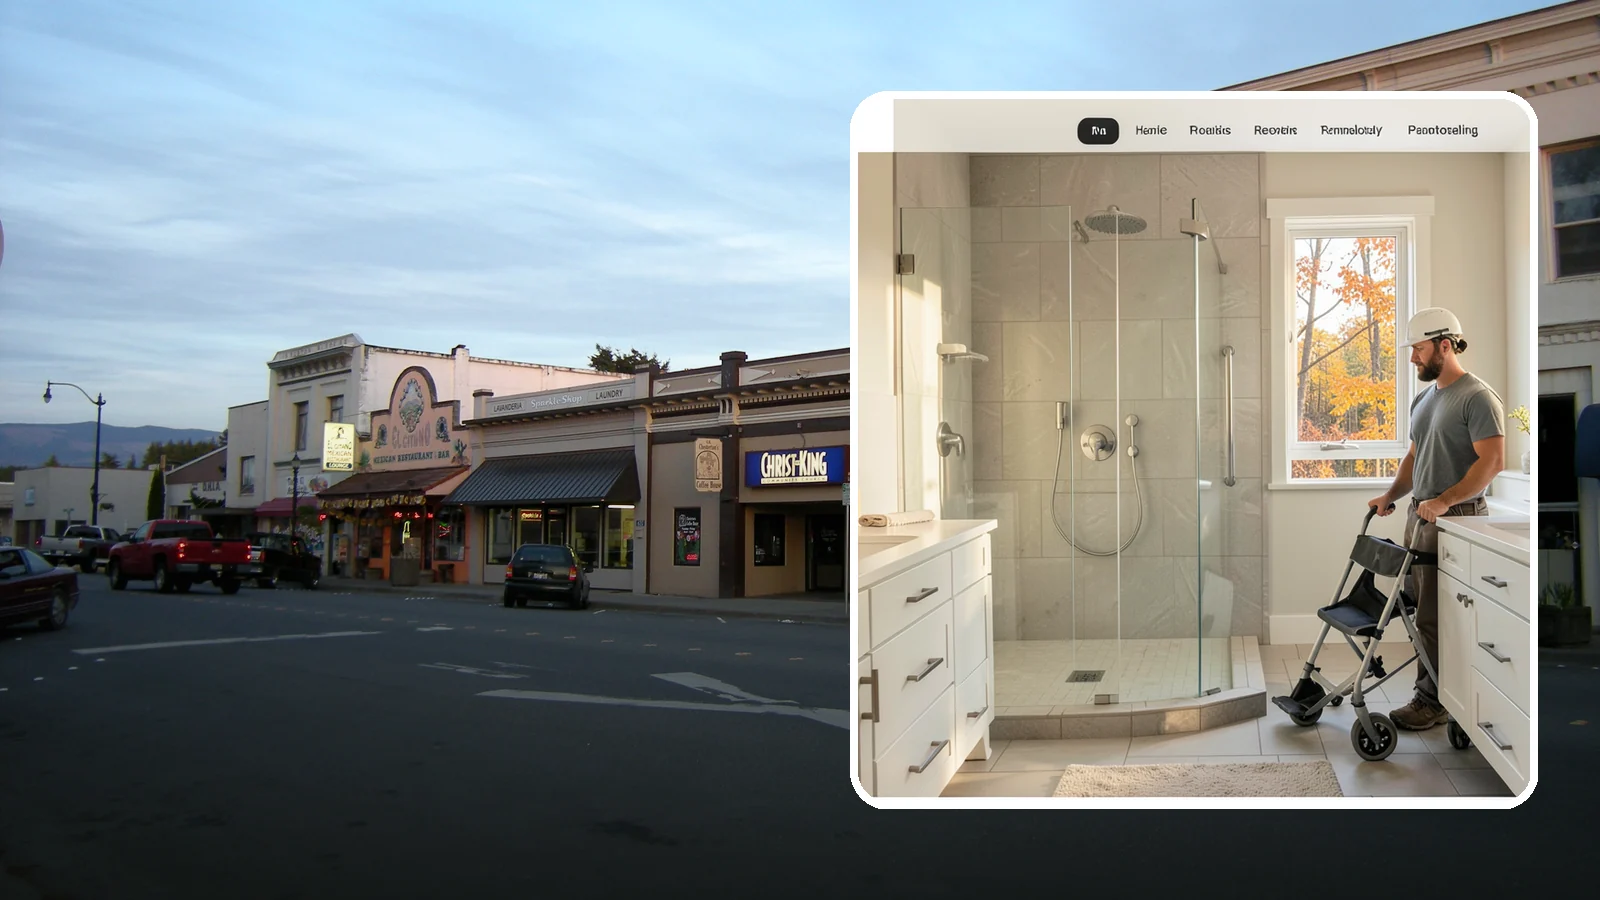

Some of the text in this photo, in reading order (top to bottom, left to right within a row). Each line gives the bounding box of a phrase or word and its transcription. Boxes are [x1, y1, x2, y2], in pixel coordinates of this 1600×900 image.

[595, 389, 623, 400] LAUNDRY
[493, 402, 523, 413] LAVANDERIA
[530, 395, 582, 409] Sparkle Shop
[373, 450, 450, 464] MEXICAN RESTAURANT BAR
[761, 450, 828, 478] CHRIST KING
